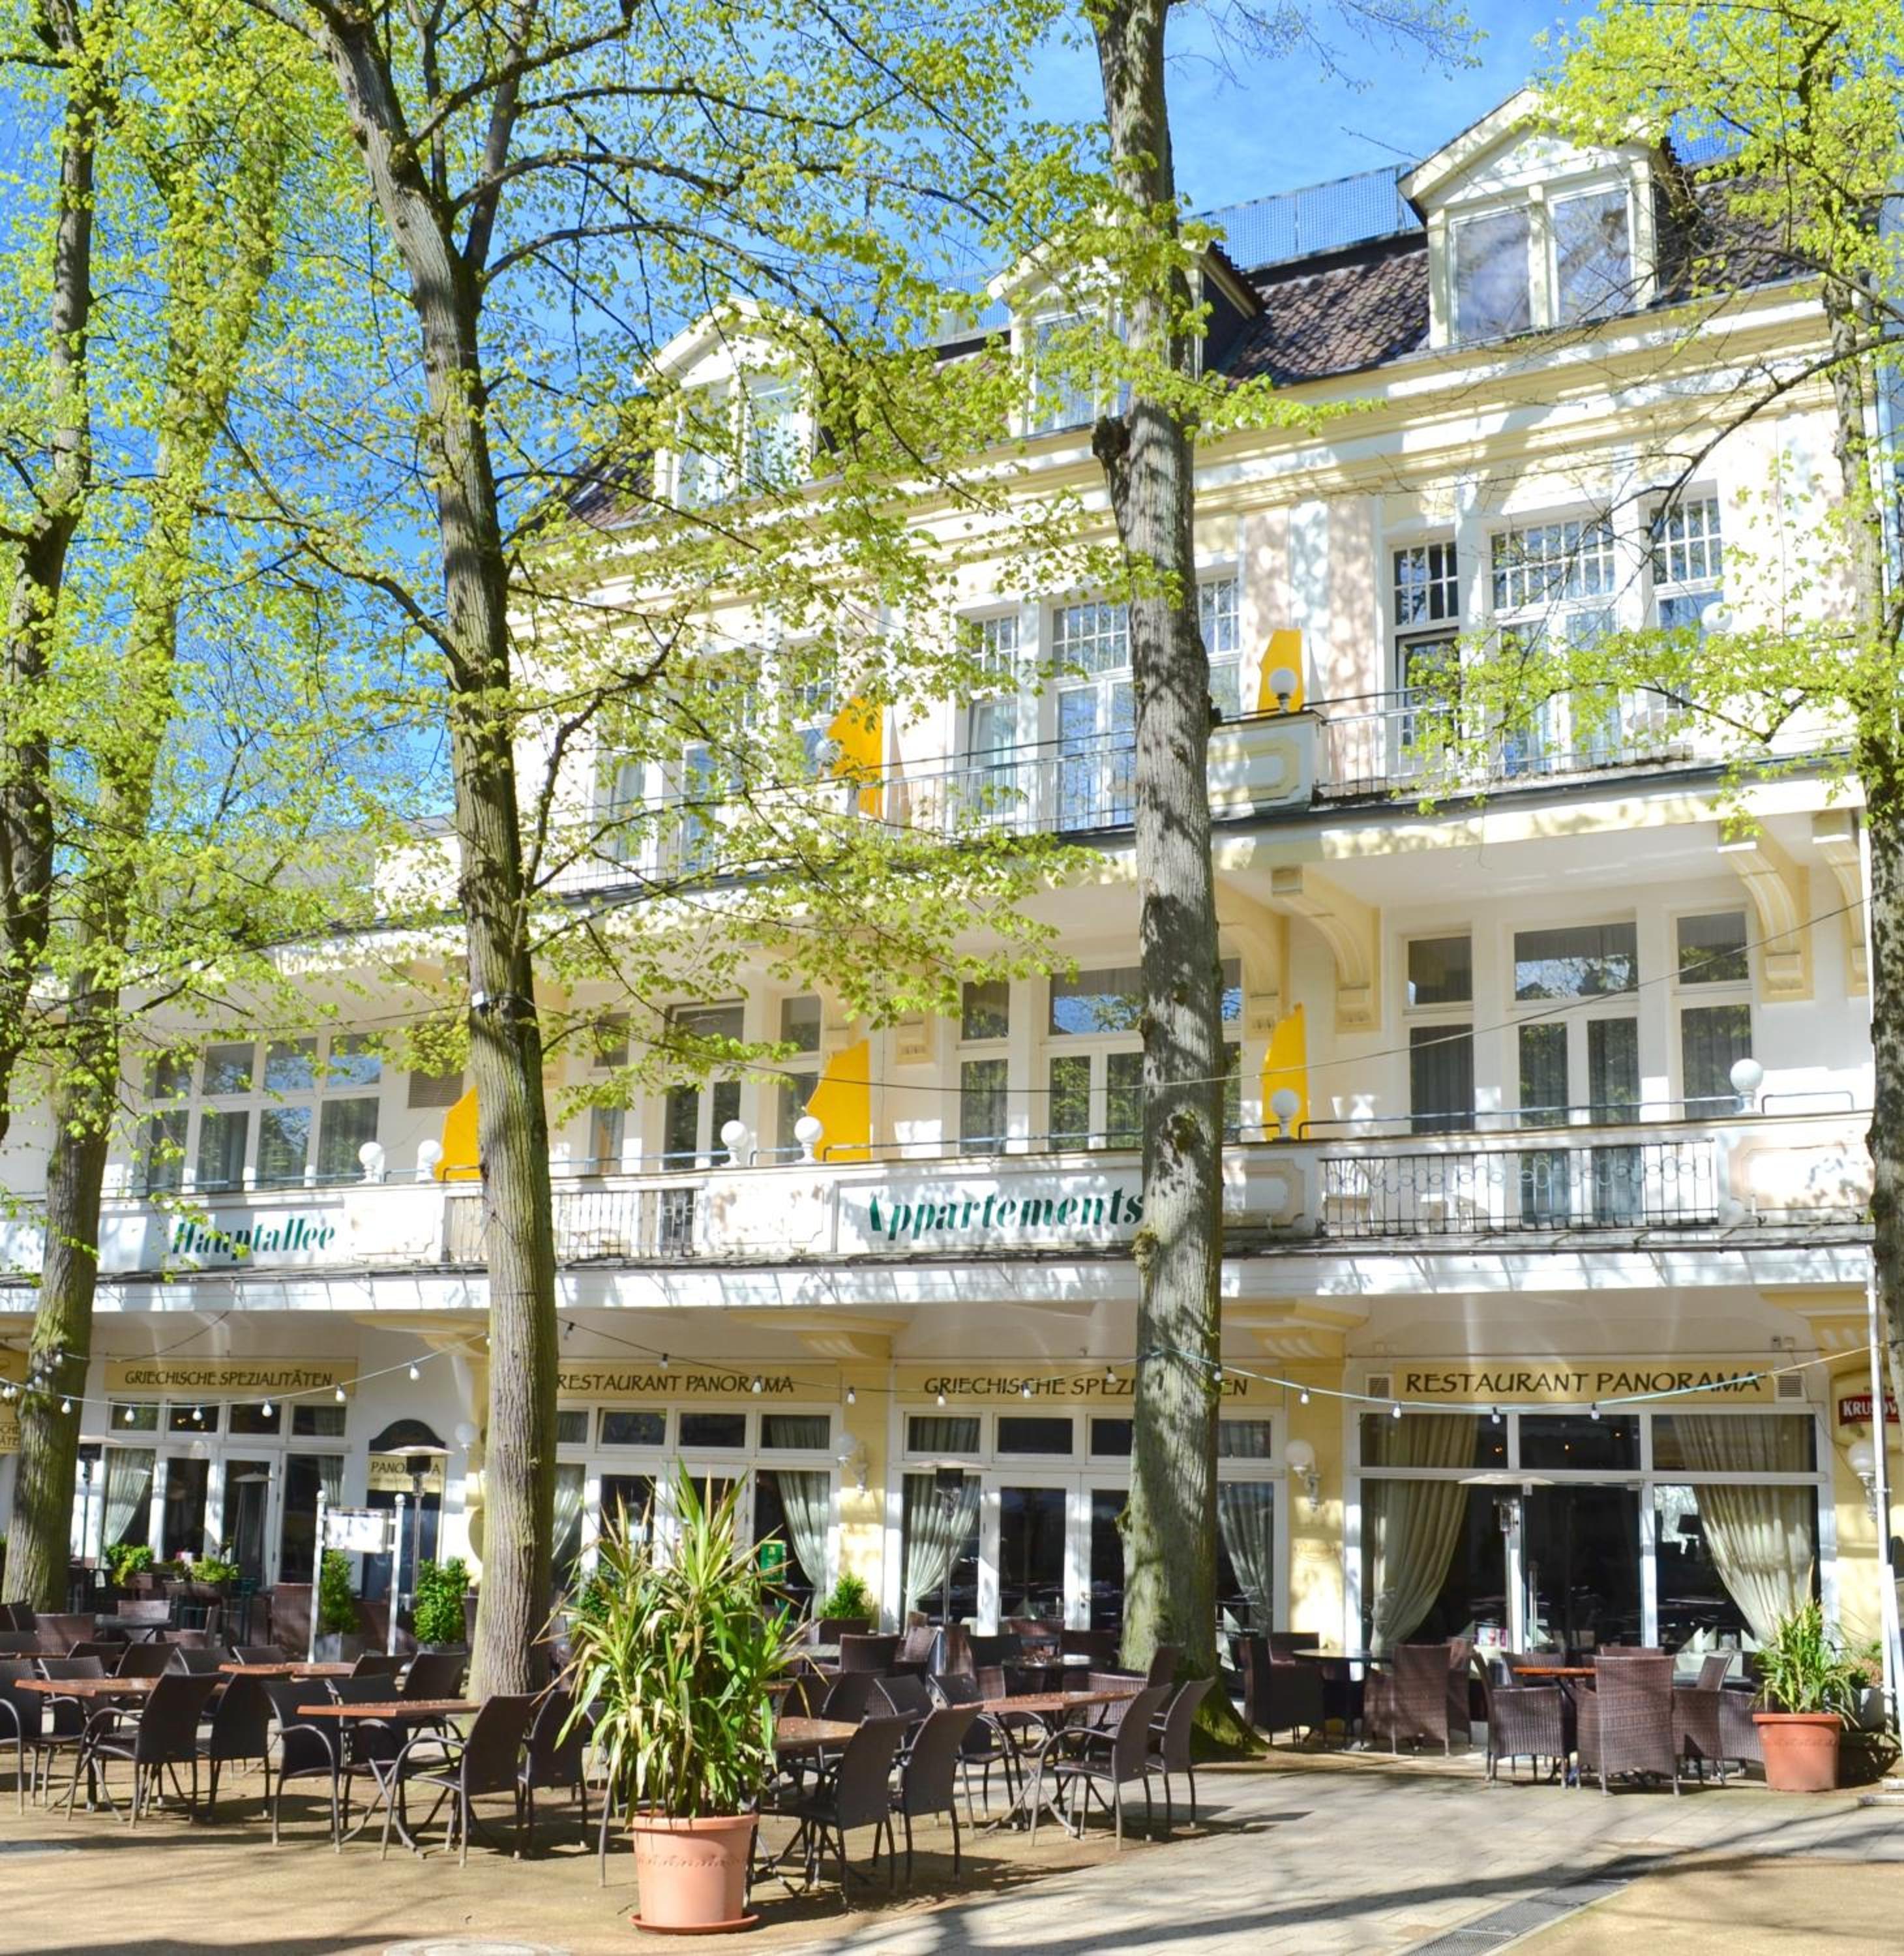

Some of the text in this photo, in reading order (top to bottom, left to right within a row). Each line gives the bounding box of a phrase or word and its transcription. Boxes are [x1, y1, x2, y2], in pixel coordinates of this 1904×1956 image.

[869, 1186, 1143, 1241] Appartements
[172, 1217, 335, 1260] Hauptallee
[125, 1369, 333, 1387] GRIECHISCHE SPEZIALITÄTEN
[557, 1374, 794, 1393] RESTAURANT PANORAMA
[923, 1376, 1248, 1396] GRIECHISCHE SPEZIEN
[1405, 1372, 1761, 1393] RESTAURANT PANORAMA
[370, 1461, 441, 1474] PANOA
